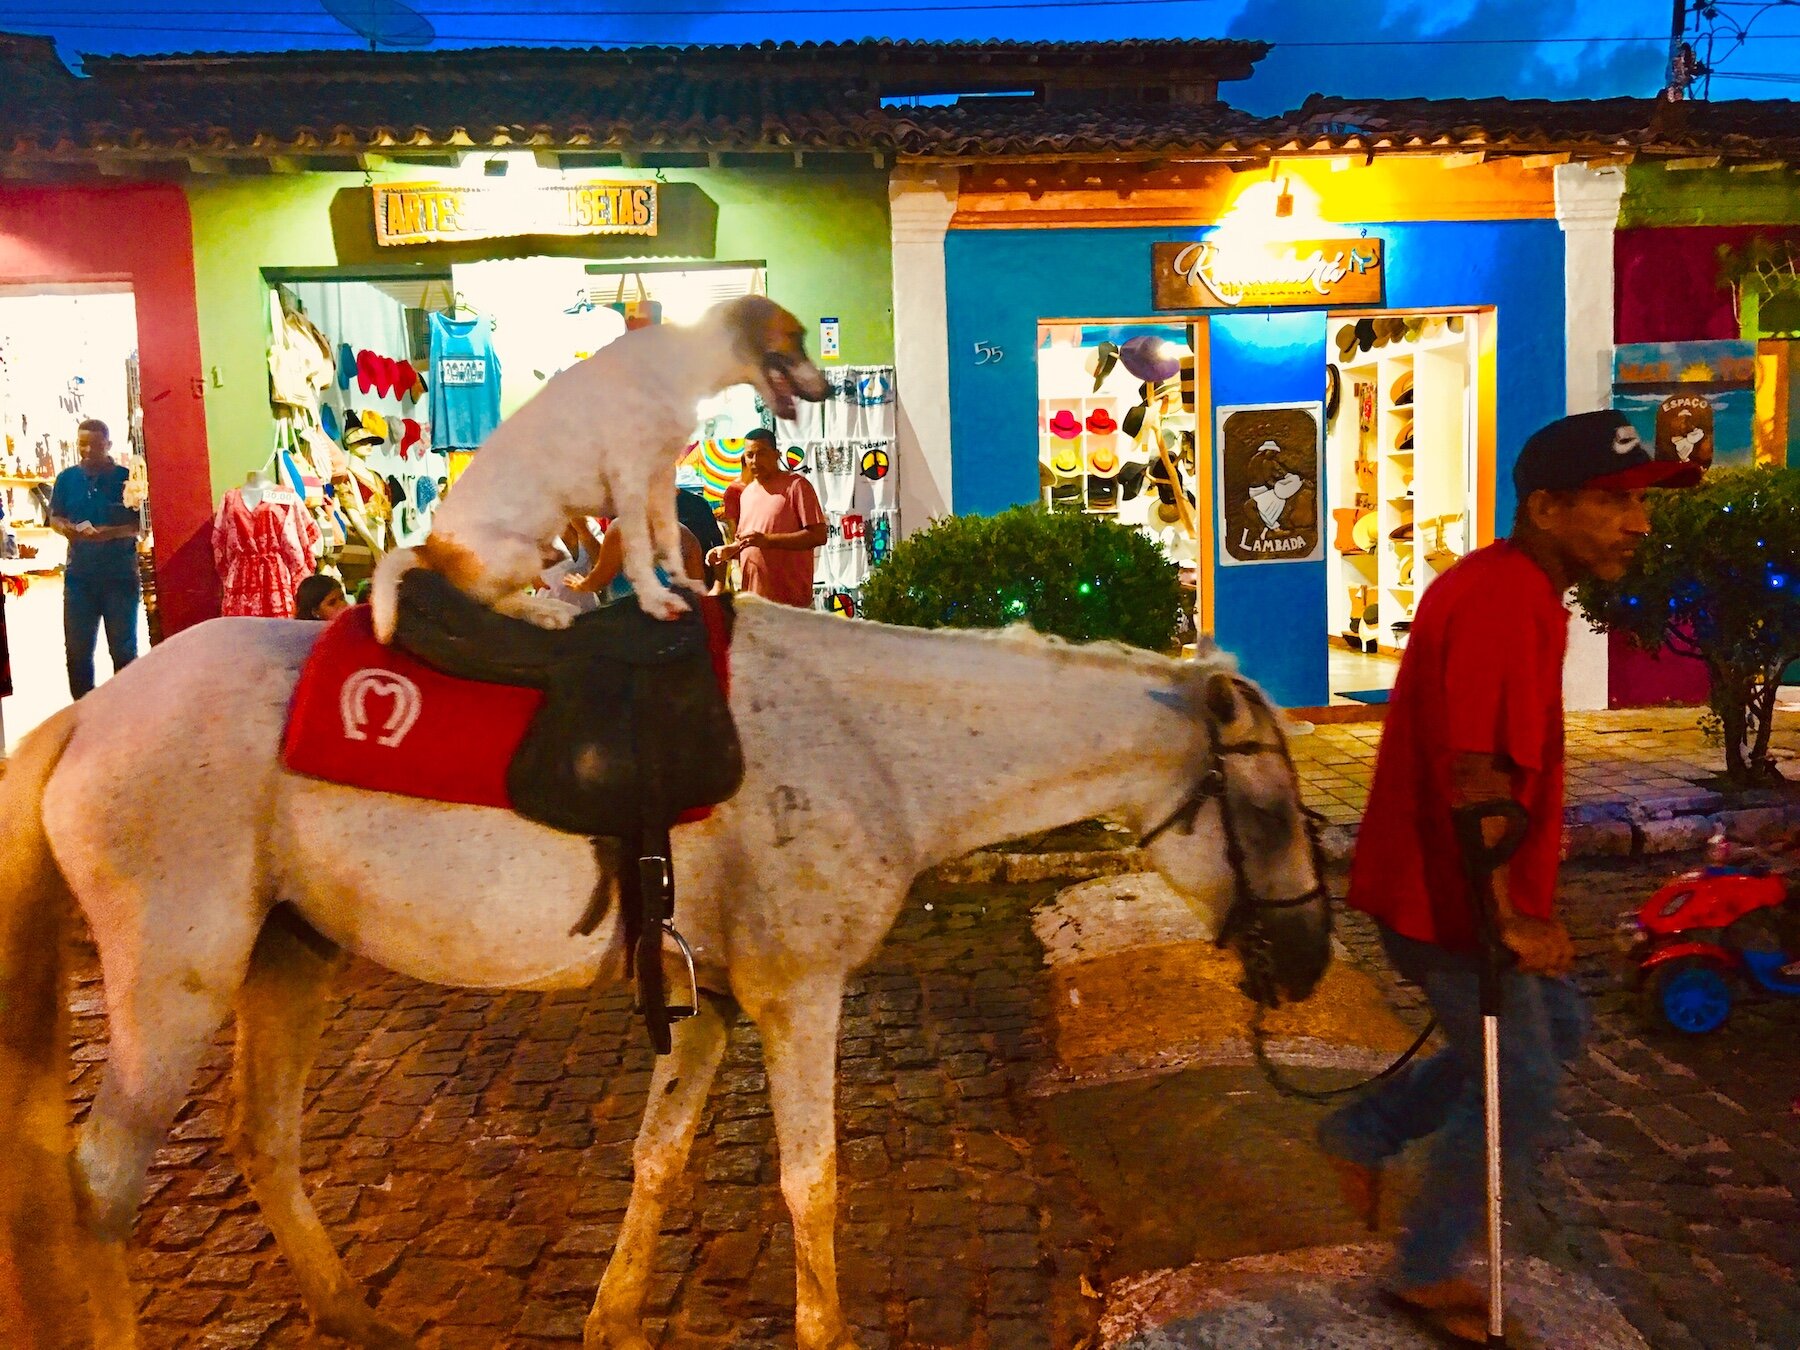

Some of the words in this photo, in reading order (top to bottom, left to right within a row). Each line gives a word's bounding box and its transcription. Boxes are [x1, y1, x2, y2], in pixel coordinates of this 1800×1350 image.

[973, 340, 1004, 365] 55
[1661, 397, 1708, 413] ESPAÇO
[1238, 526, 1307, 553] LAMBADA
